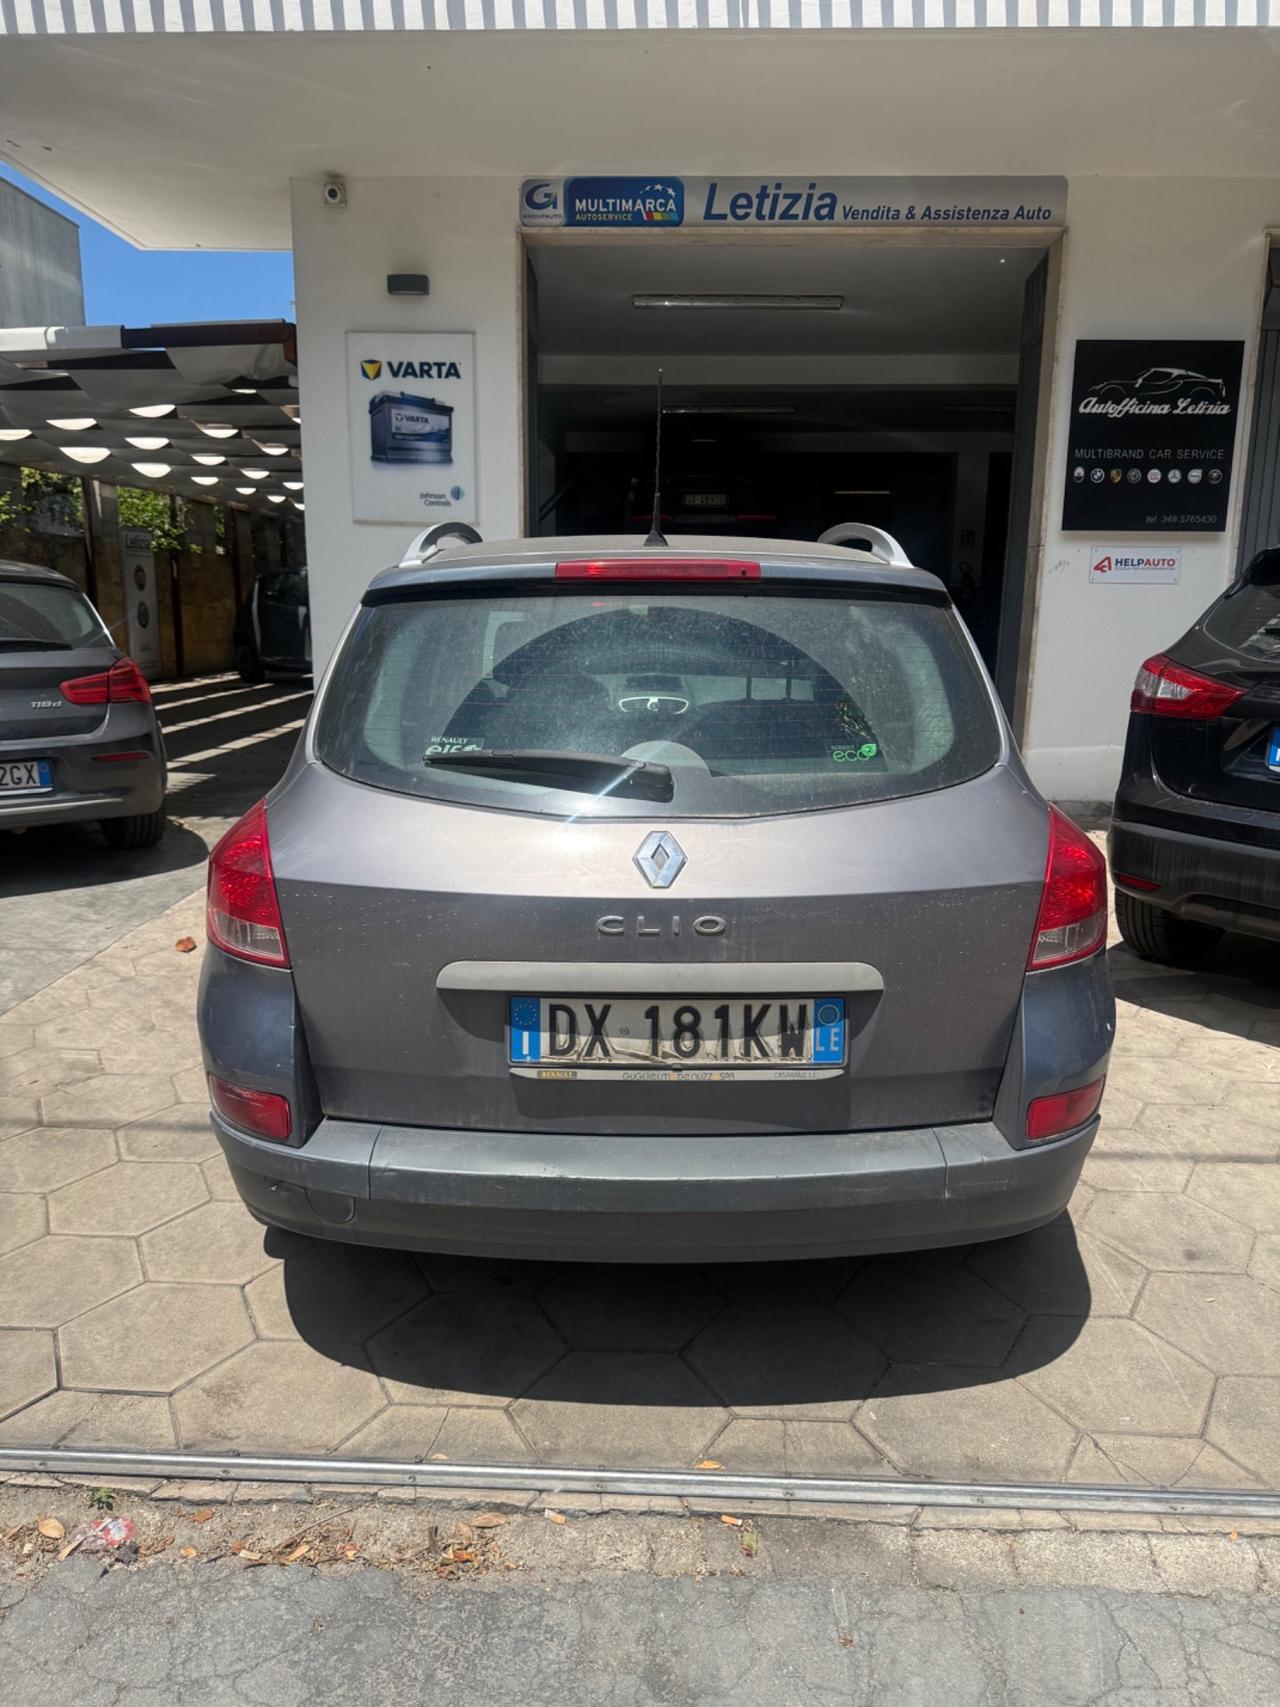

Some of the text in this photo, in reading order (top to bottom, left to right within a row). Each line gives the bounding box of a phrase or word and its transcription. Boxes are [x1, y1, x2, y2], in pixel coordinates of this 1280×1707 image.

[575, 198, 677, 213] MULTIMARCA
[703, 182, 1051, 221] Letizia Vendita & Assistenza Auto
[575, 213, 633, 221] AUTOSERVICE
[387, 361, 461, 379] VARTA
[1079, 397, 1231, 419] Autofficina Letizia
[404, 414, 430, 425] VARTA
[1075, 448, 1224, 460] MULTIBRAND CAR SERVICE
[419, 492, 446, 500] Johnson
[1115, 558, 1175, 567] HELPAUTO
[431, 735, 468, 744] RENAULT
[596, 914, 727, 936] CLIO
[550, 1003, 808, 1058] DX 181KW
[820, 1027, 839, 1052] LE
